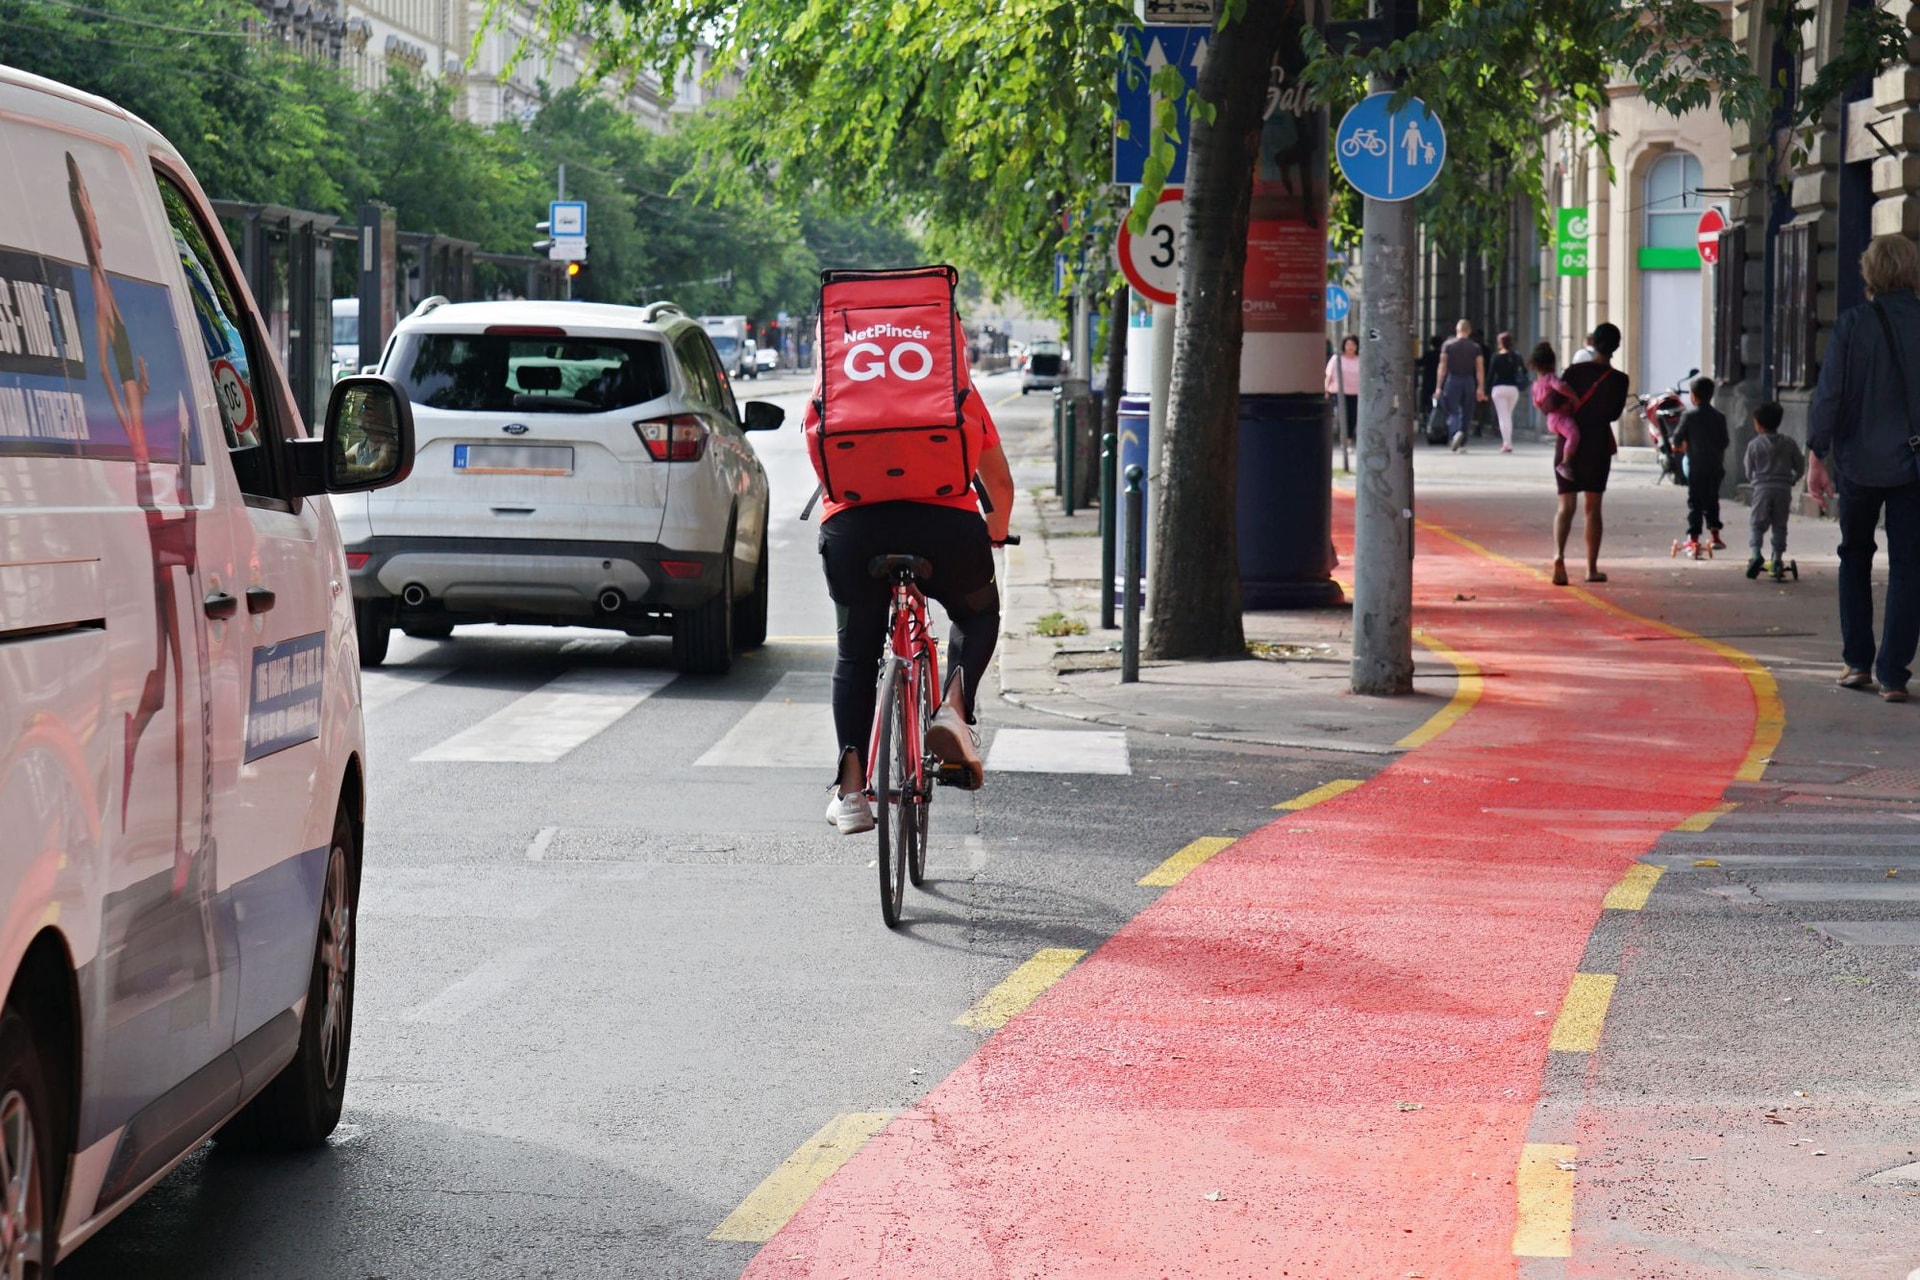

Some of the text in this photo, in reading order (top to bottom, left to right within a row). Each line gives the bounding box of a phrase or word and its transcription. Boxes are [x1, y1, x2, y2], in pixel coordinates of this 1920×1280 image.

[1150, 224, 1175, 268] 3
[1562, 254, 1588, 267] 0-2
[843, 323, 930, 344] NetPincér
[843, 342, 933, 381] GO
